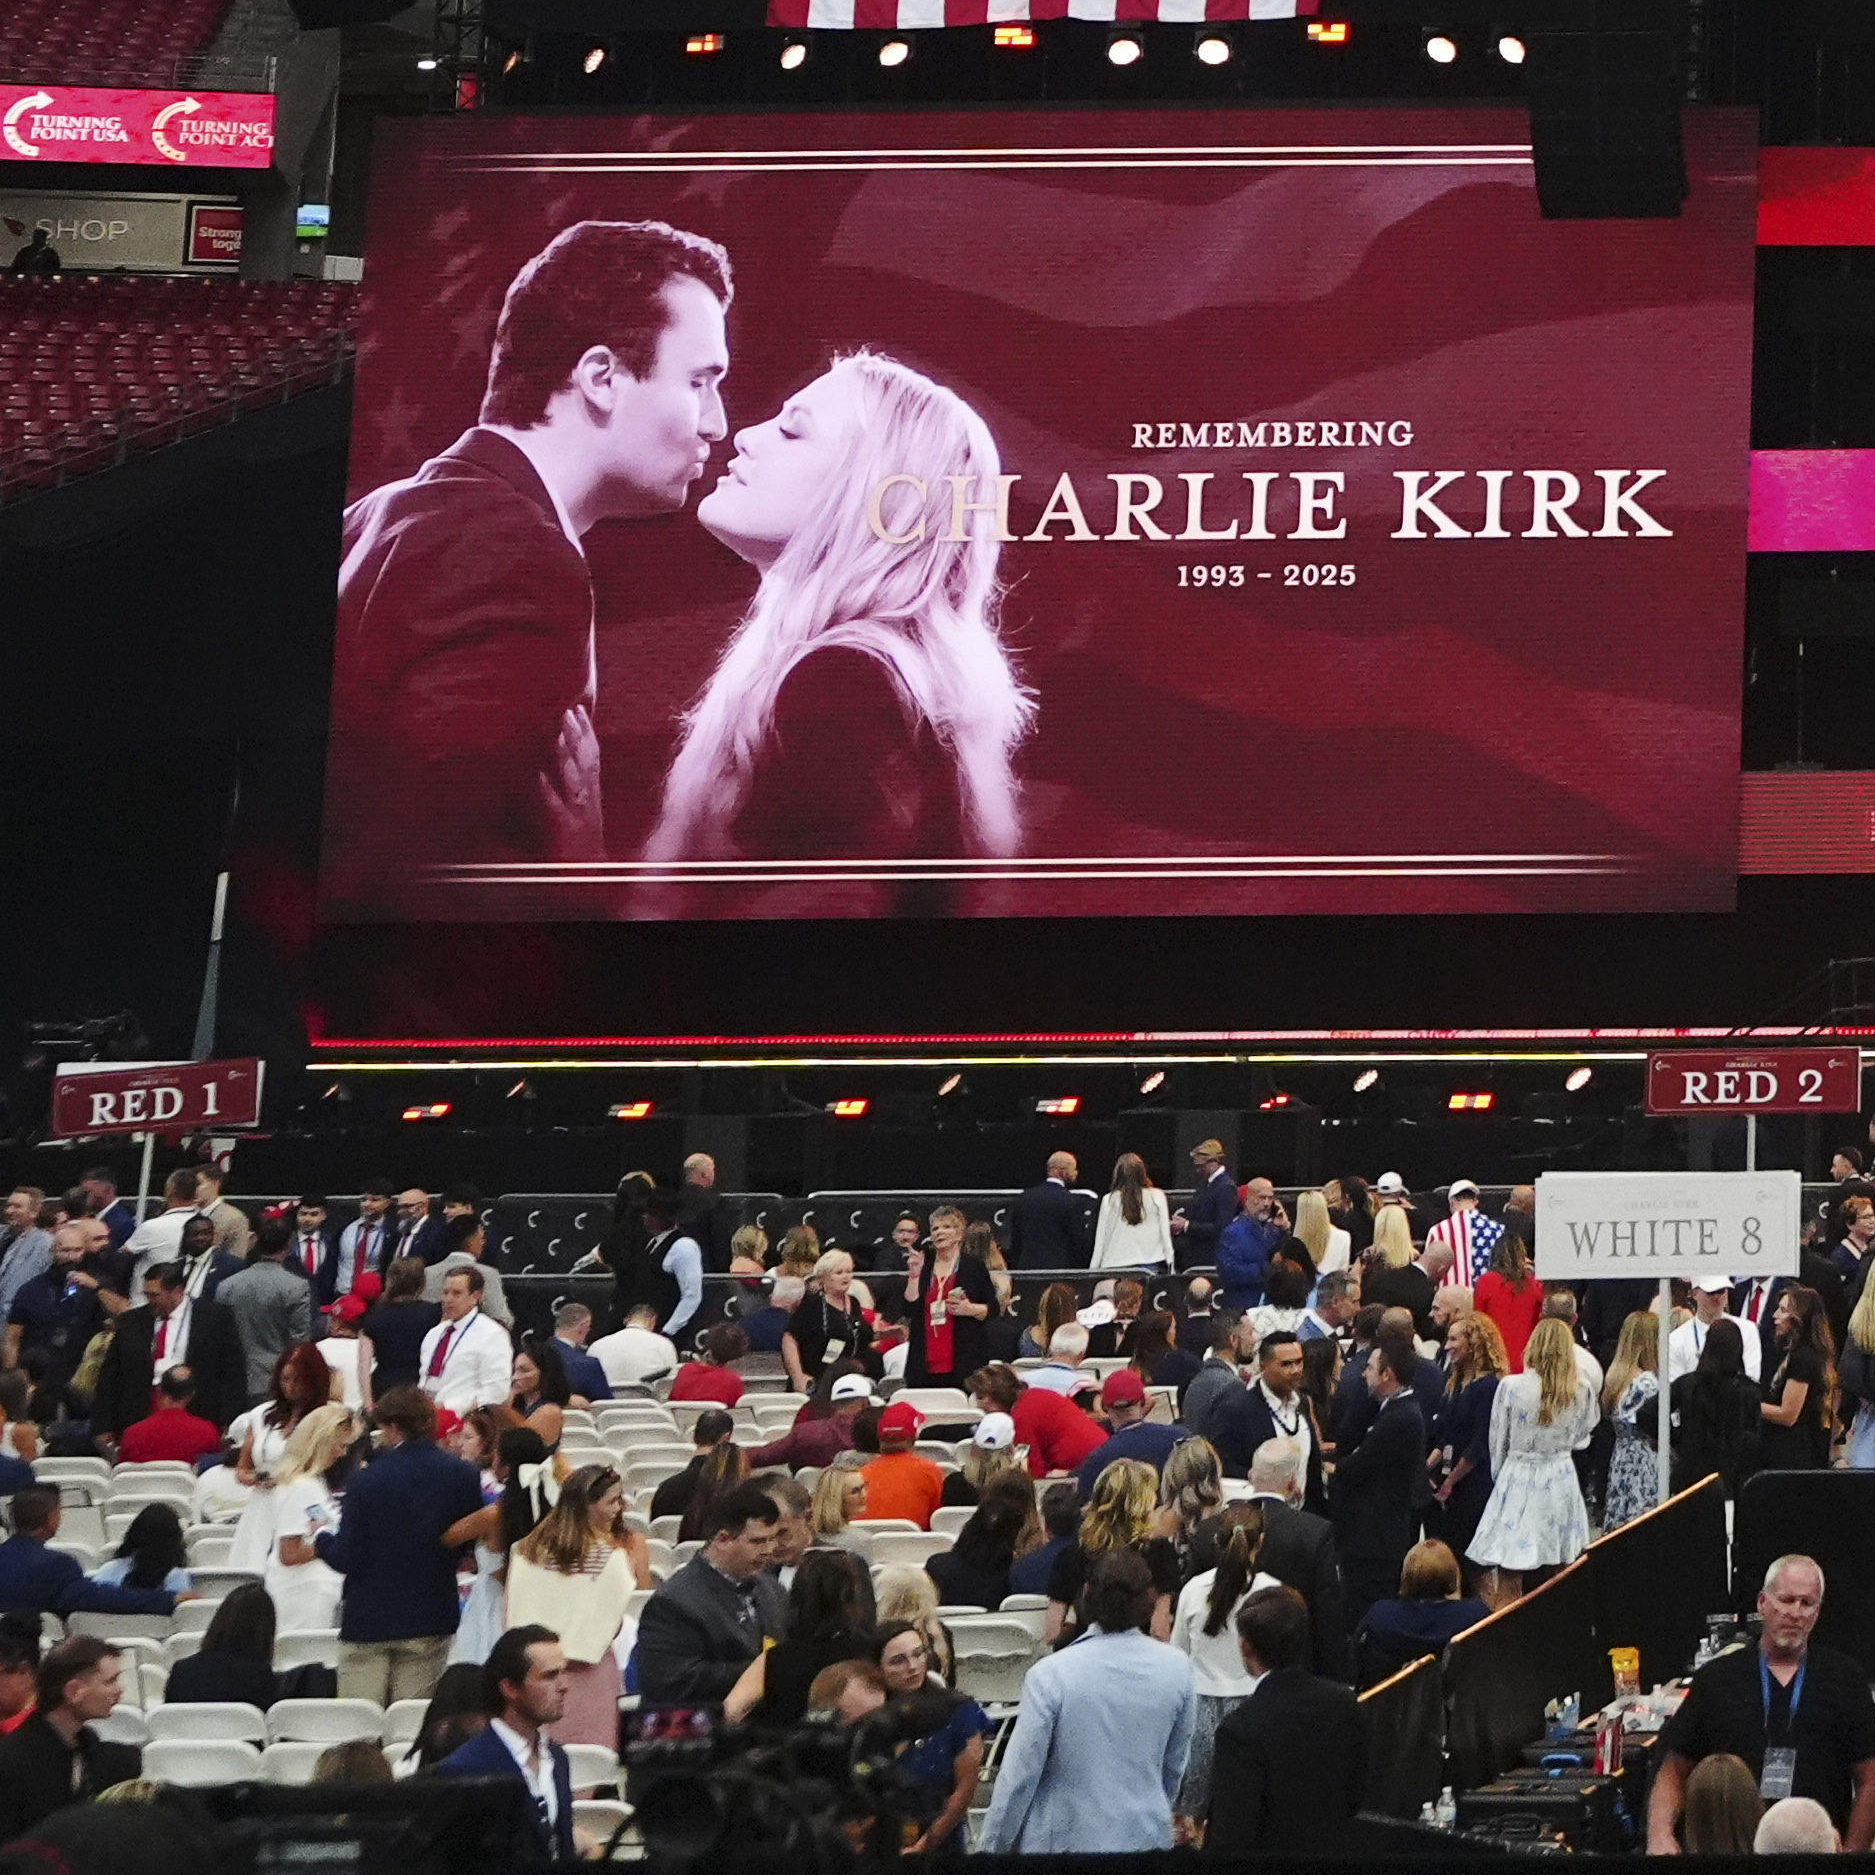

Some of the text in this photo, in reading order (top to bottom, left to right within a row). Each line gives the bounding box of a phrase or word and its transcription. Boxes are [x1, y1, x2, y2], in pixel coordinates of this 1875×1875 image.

[30, 114, 122, 131] TURNING
[179, 119, 270, 135] TURNING
[30, 127, 130, 143] POINT USA
[179, 132, 275, 148] POINT ACT
[36, 218, 130, 242] SHOP
[1132, 422, 1415, 448] REMEMBERING
[867, 469, 1673, 545] CHARLIE KIRK
[1177, 565, 1245, 588] 1993
[1284, 564, 1356, 587] 2025
[1680, 1069, 1824, 1104] RED 2
[88, 1082, 220, 1126] RED 1
[1566, 1216, 1762, 1258] WHITE 8
